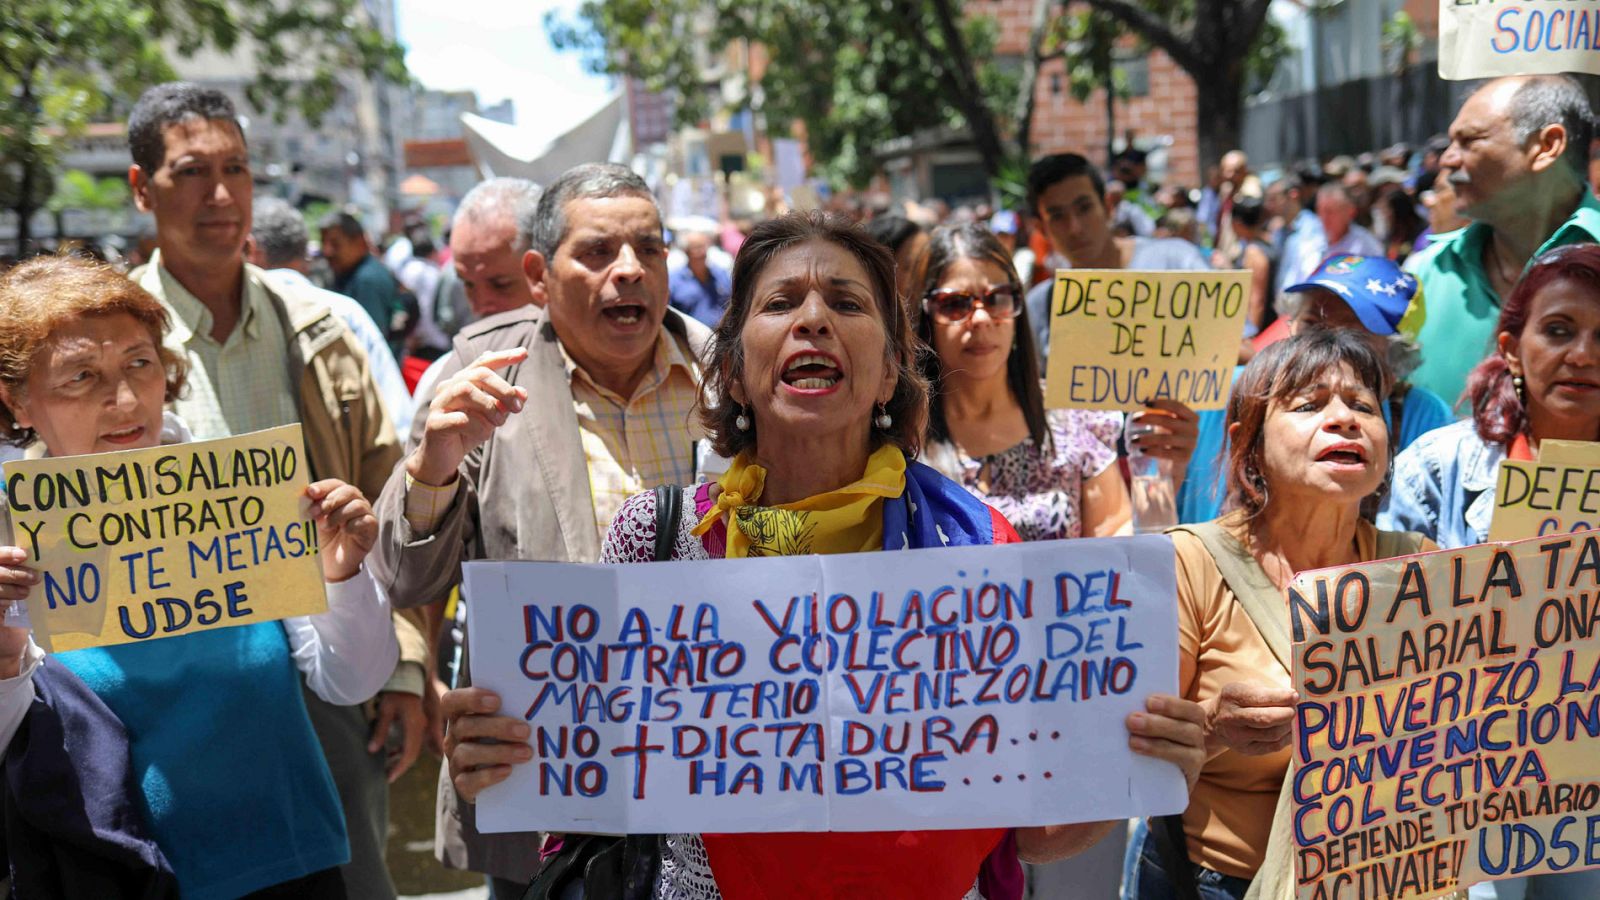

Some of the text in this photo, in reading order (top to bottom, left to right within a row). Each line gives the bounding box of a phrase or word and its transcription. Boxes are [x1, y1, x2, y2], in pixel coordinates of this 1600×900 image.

[1490, 8, 1600, 54] SOCIAL
[1056, 278, 1243, 319] DESPLOMO
[1110, 322, 1196, 357] DE LA
[1070, 355, 1227, 404] EDUCACIÓN
[7, 446, 297, 512] CON MI SALARIO
[19, 496, 264, 562] Y CONTRATO
[44, 519, 319, 610] NO TE METAS!!
[1288, 571, 1370, 643] NO
[1386, 561, 1431, 623] A
[1453, 550, 1522, 608] LA
[118, 581, 253, 639] UDSE
[523, 604, 600, 644] NO
[752, 568, 1034, 636] VIOLACIÓN
[1054, 569, 1132, 618] DEL
[519, 616, 1143, 686] CONTRATO COLECTIVO DEL
[1303, 608, 1516, 695] SALARIAL
[525, 656, 1137, 724] MAGISTERIO VENEZOLANO
[1296, 647, 1541, 763] PULVERIZÓ
[537, 724, 601, 760] NO
[1292, 694, 1600, 805] CONVENCIÓN
[539, 761, 608, 797] NO
[1294, 750, 1547, 847] COLECTIVA
[1298, 783, 1600, 885] DEFIENDE TU SALARIO
[1311, 815, 1600, 900] ACTIVATE!! UDSE
